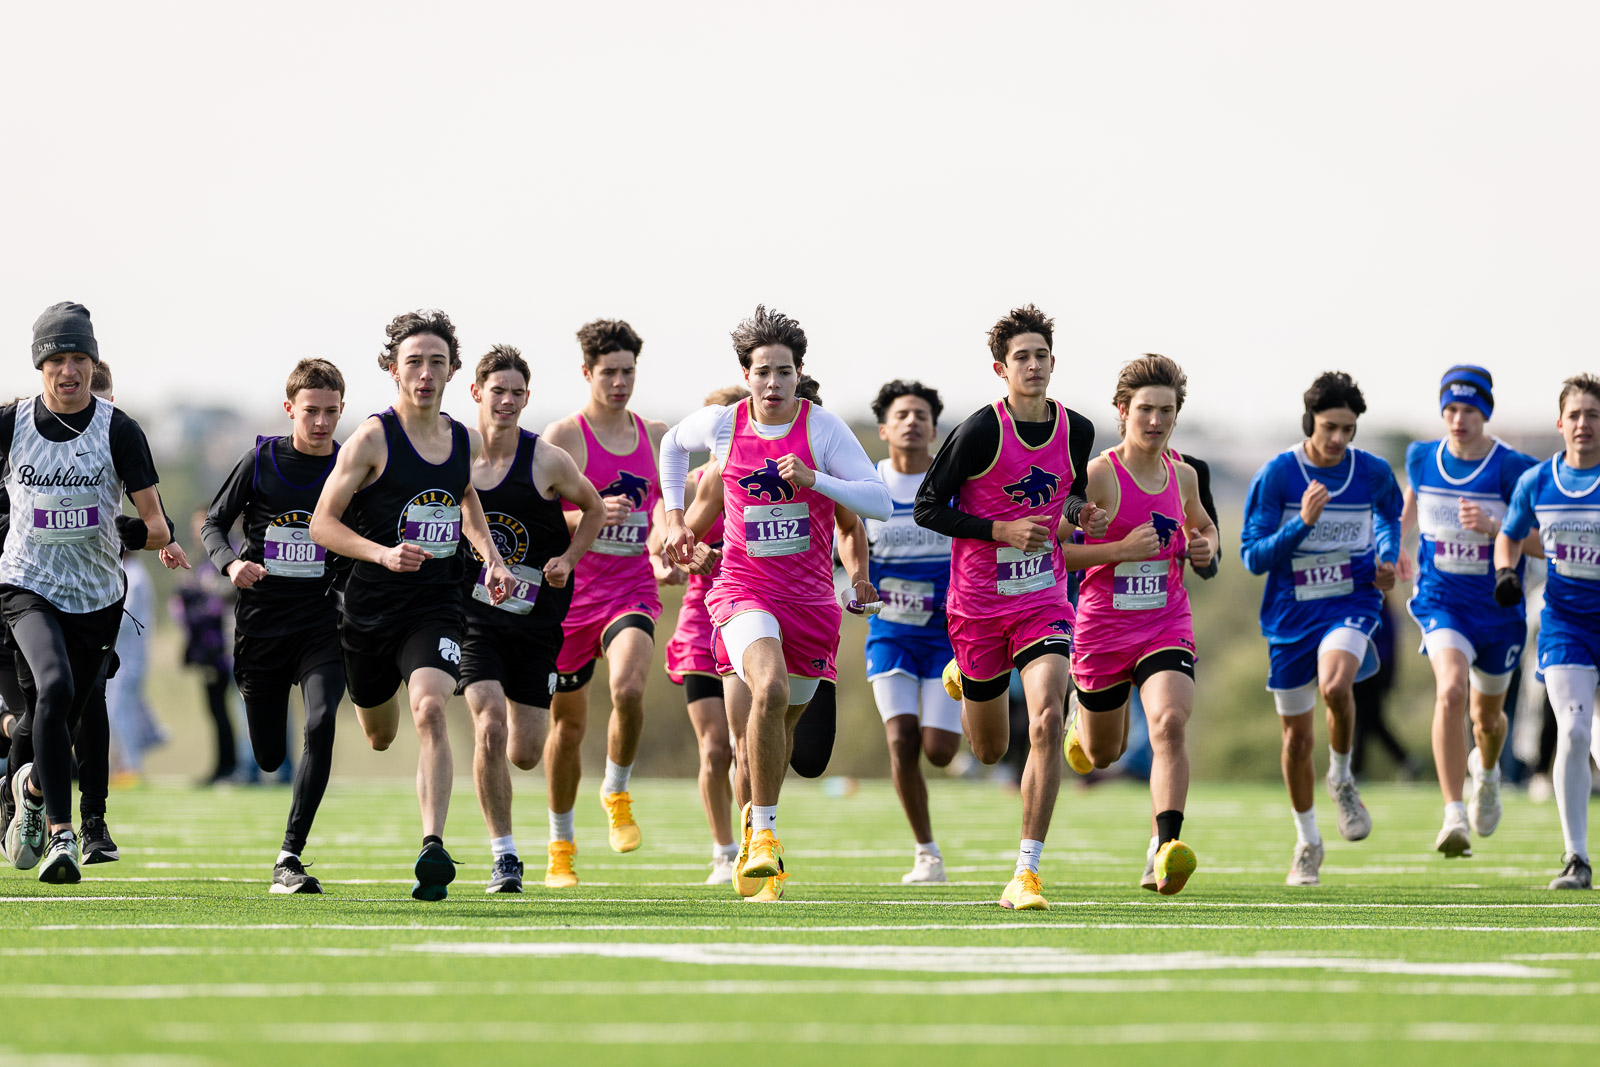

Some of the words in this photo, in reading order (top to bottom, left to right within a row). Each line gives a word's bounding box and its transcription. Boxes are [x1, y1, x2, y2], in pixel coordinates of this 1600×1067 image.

[18, 464, 105, 487] Bushland
[45, 509, 88, 529] 1090
[416, 523, 454, 542] 1079
[601, 525, 639, 543] 1144
[757, 520, 800, 541] 1152
[276, 543, 316, 561] 1080
[1444, 543, 1479, 561] 1123
[1565, 546, 1600, 565] 1127
[1010, 555, 1043, 579] 1147
[1304, 565, 1343, 585] 1124
[1126, 576, 1160, 594] 1151
[889, 592, 924, 612] 1125
